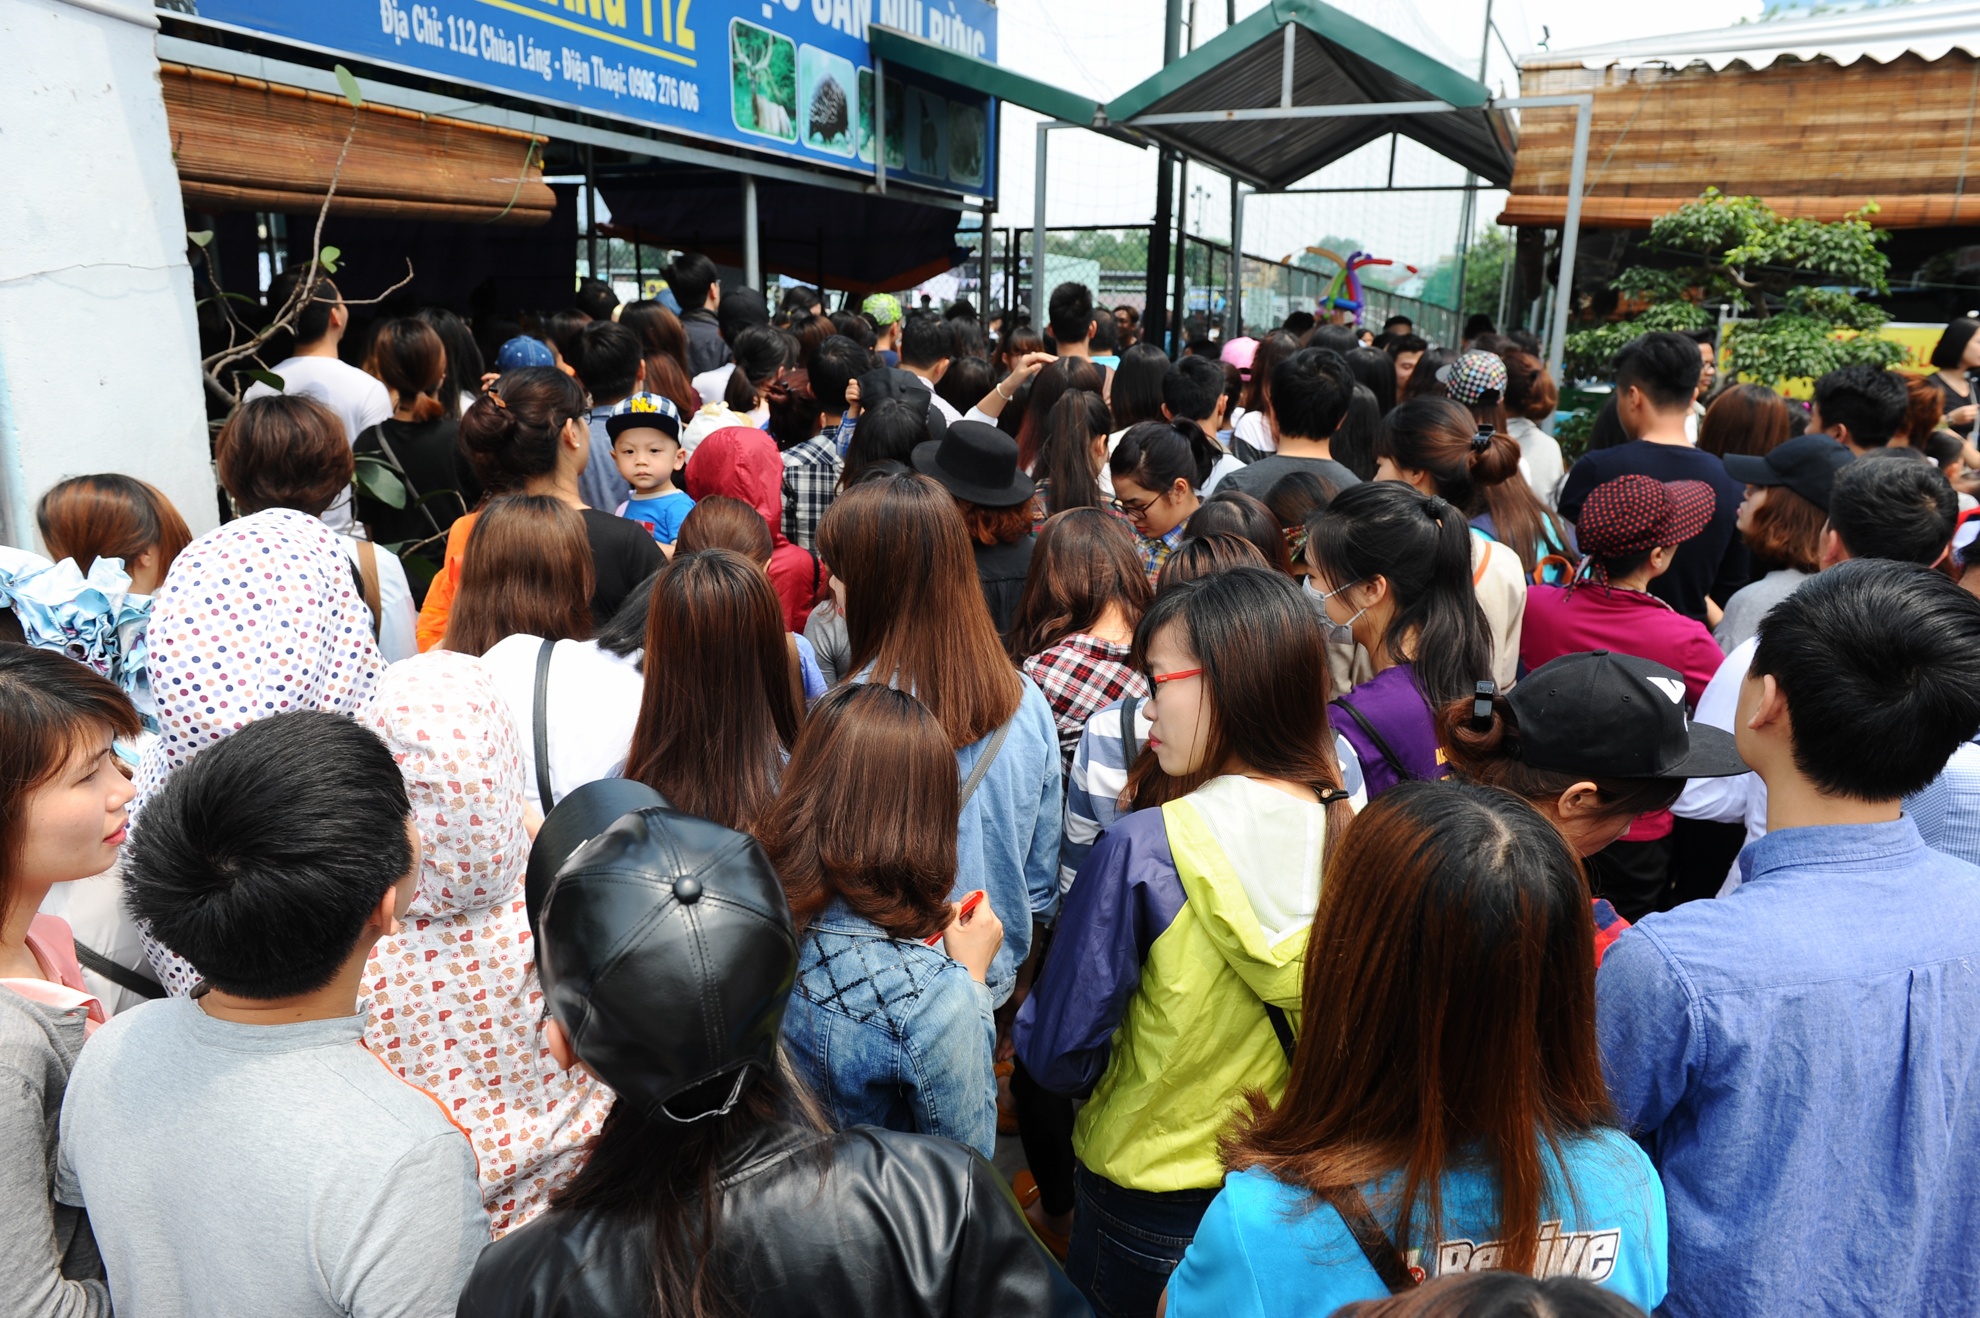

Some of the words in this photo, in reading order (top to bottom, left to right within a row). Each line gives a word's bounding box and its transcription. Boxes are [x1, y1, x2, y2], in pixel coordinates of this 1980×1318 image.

[447, 14, 479, 58] 112
[480, 23, 518, 67] Chùa
[517, 33, 553, 82] Láng
[561, 46, 591, 91] Điện
[657, 73, 679, 108] 276
